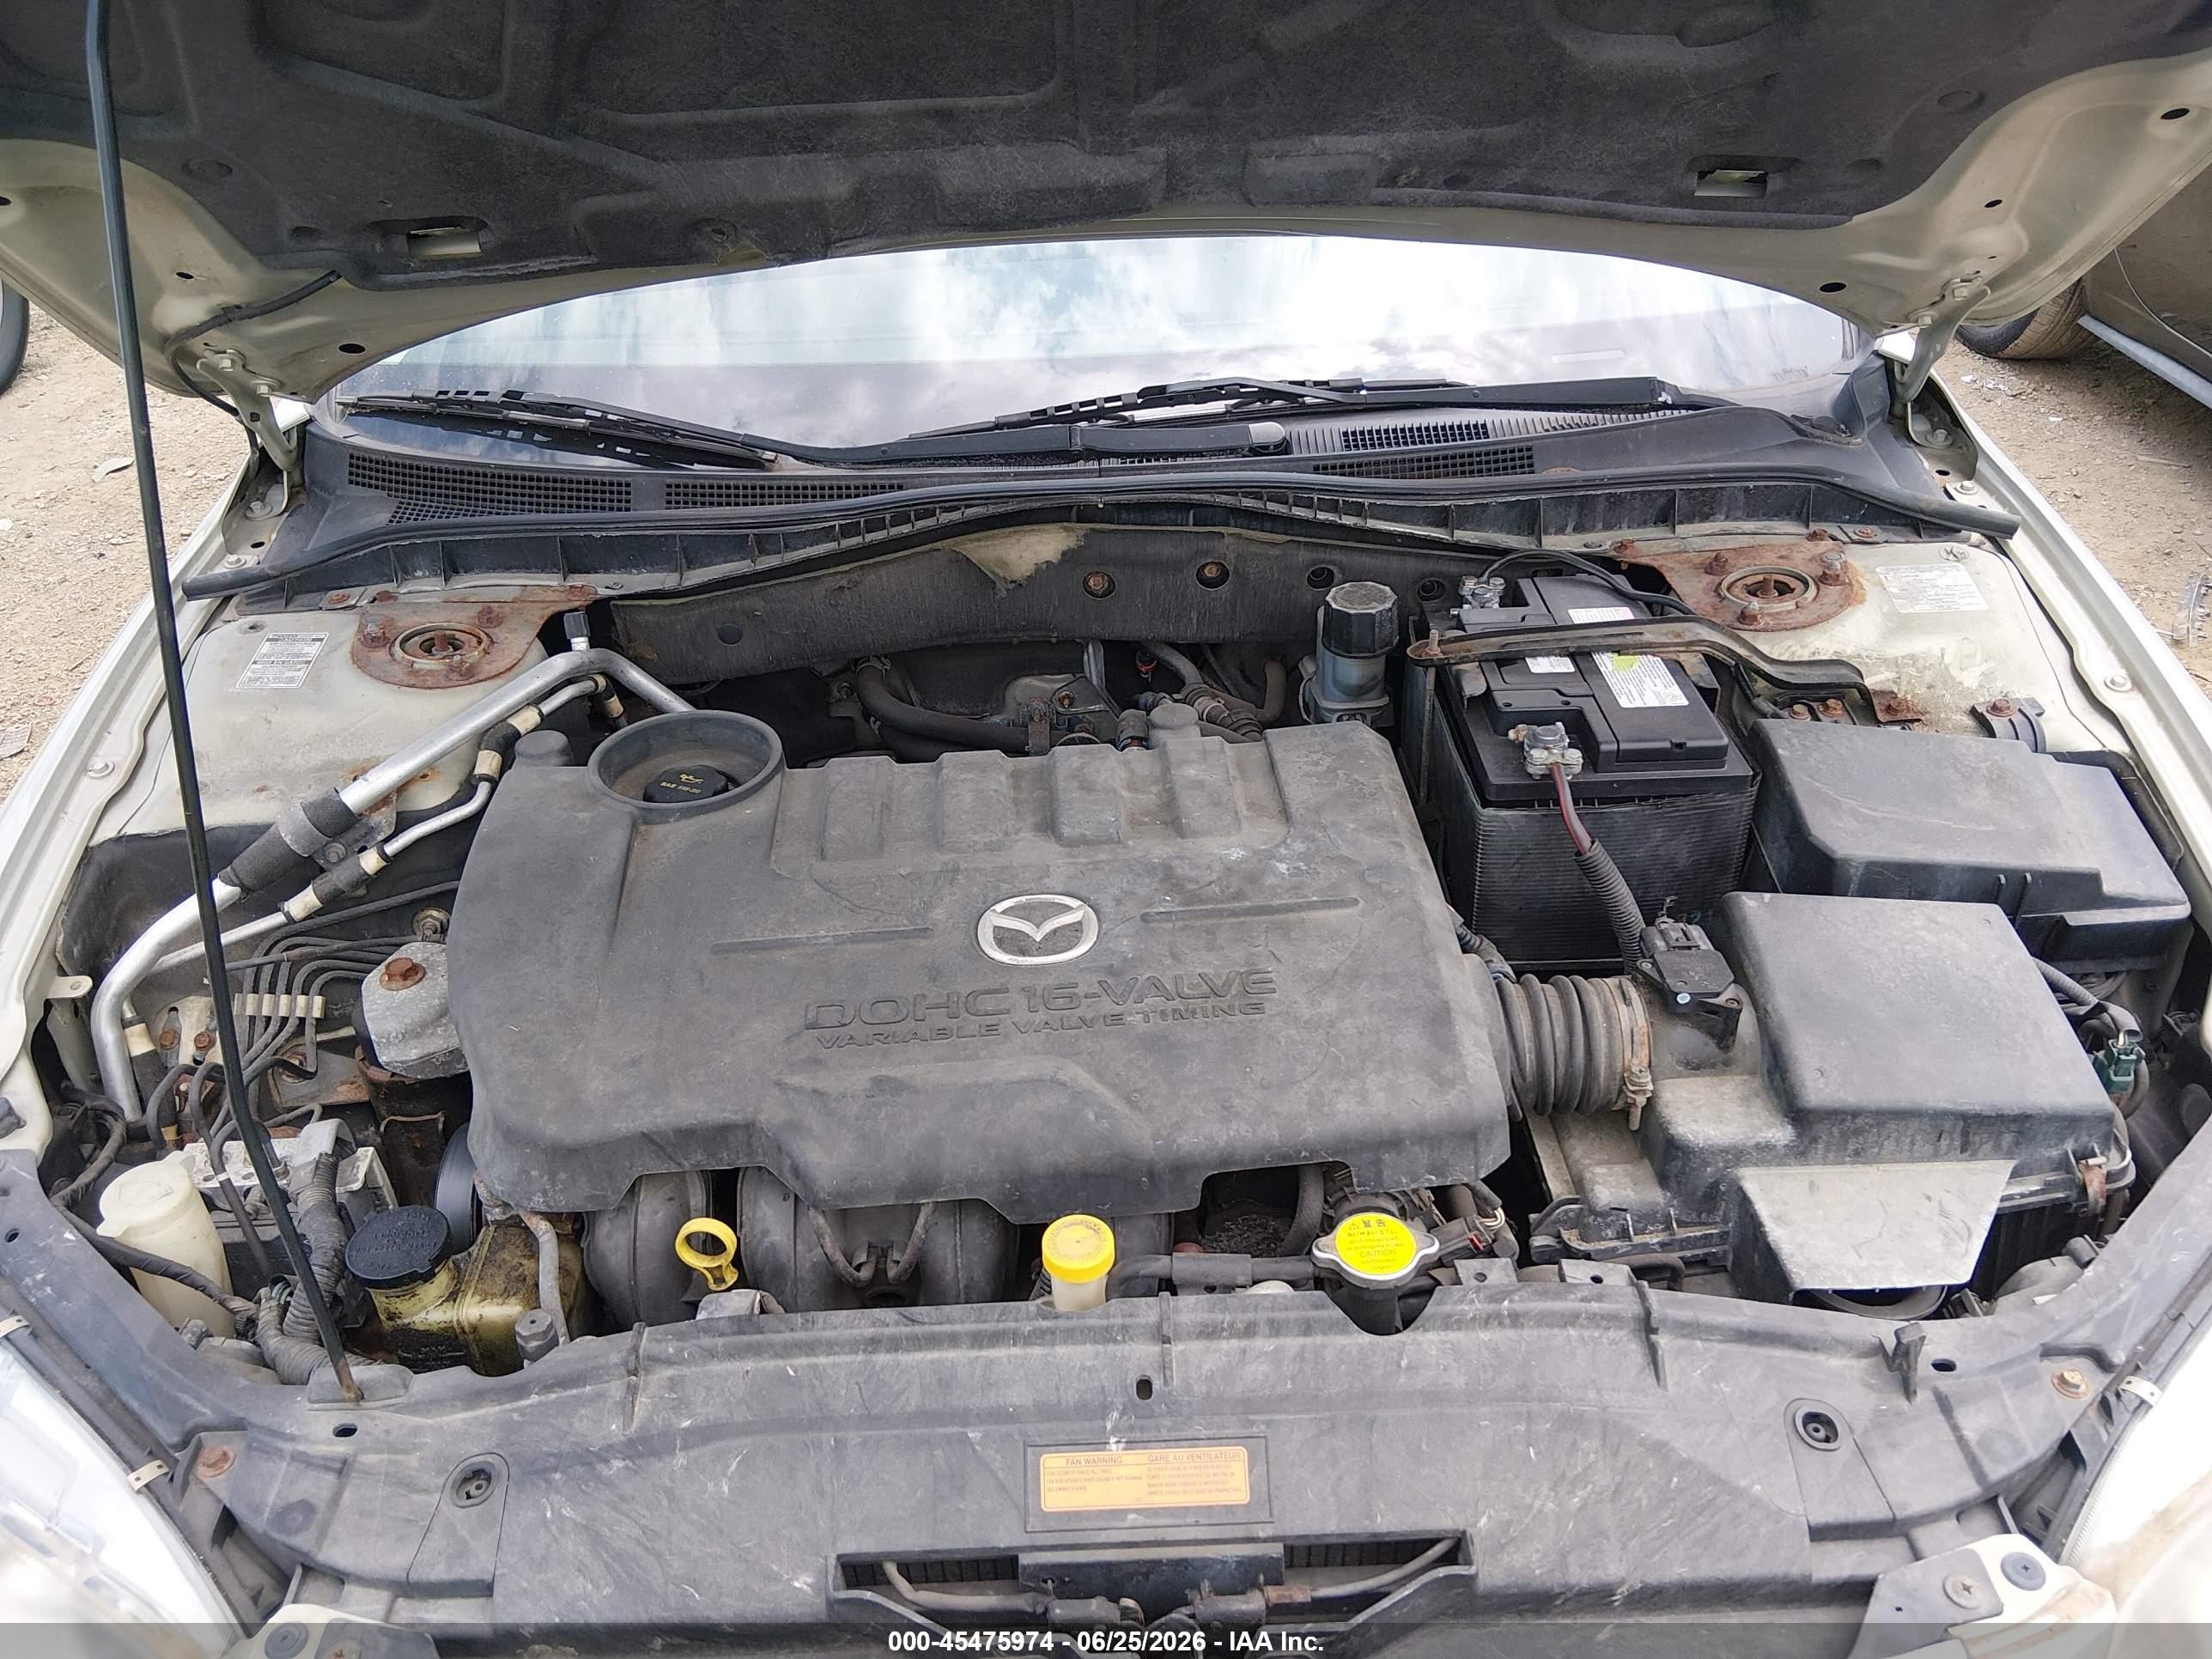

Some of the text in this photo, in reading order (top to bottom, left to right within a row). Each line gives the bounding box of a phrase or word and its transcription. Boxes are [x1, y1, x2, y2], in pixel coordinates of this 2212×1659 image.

[805, 969, 1277, 1030] DOHC 16-VALVE
[817, 1003, 1266, 1048] VARIABLE VALVE TIMING
[1066, 1455, 1123, 1466] FAN WARNING
[1187, 1452, 1241, 1461] VENTILATEUR
